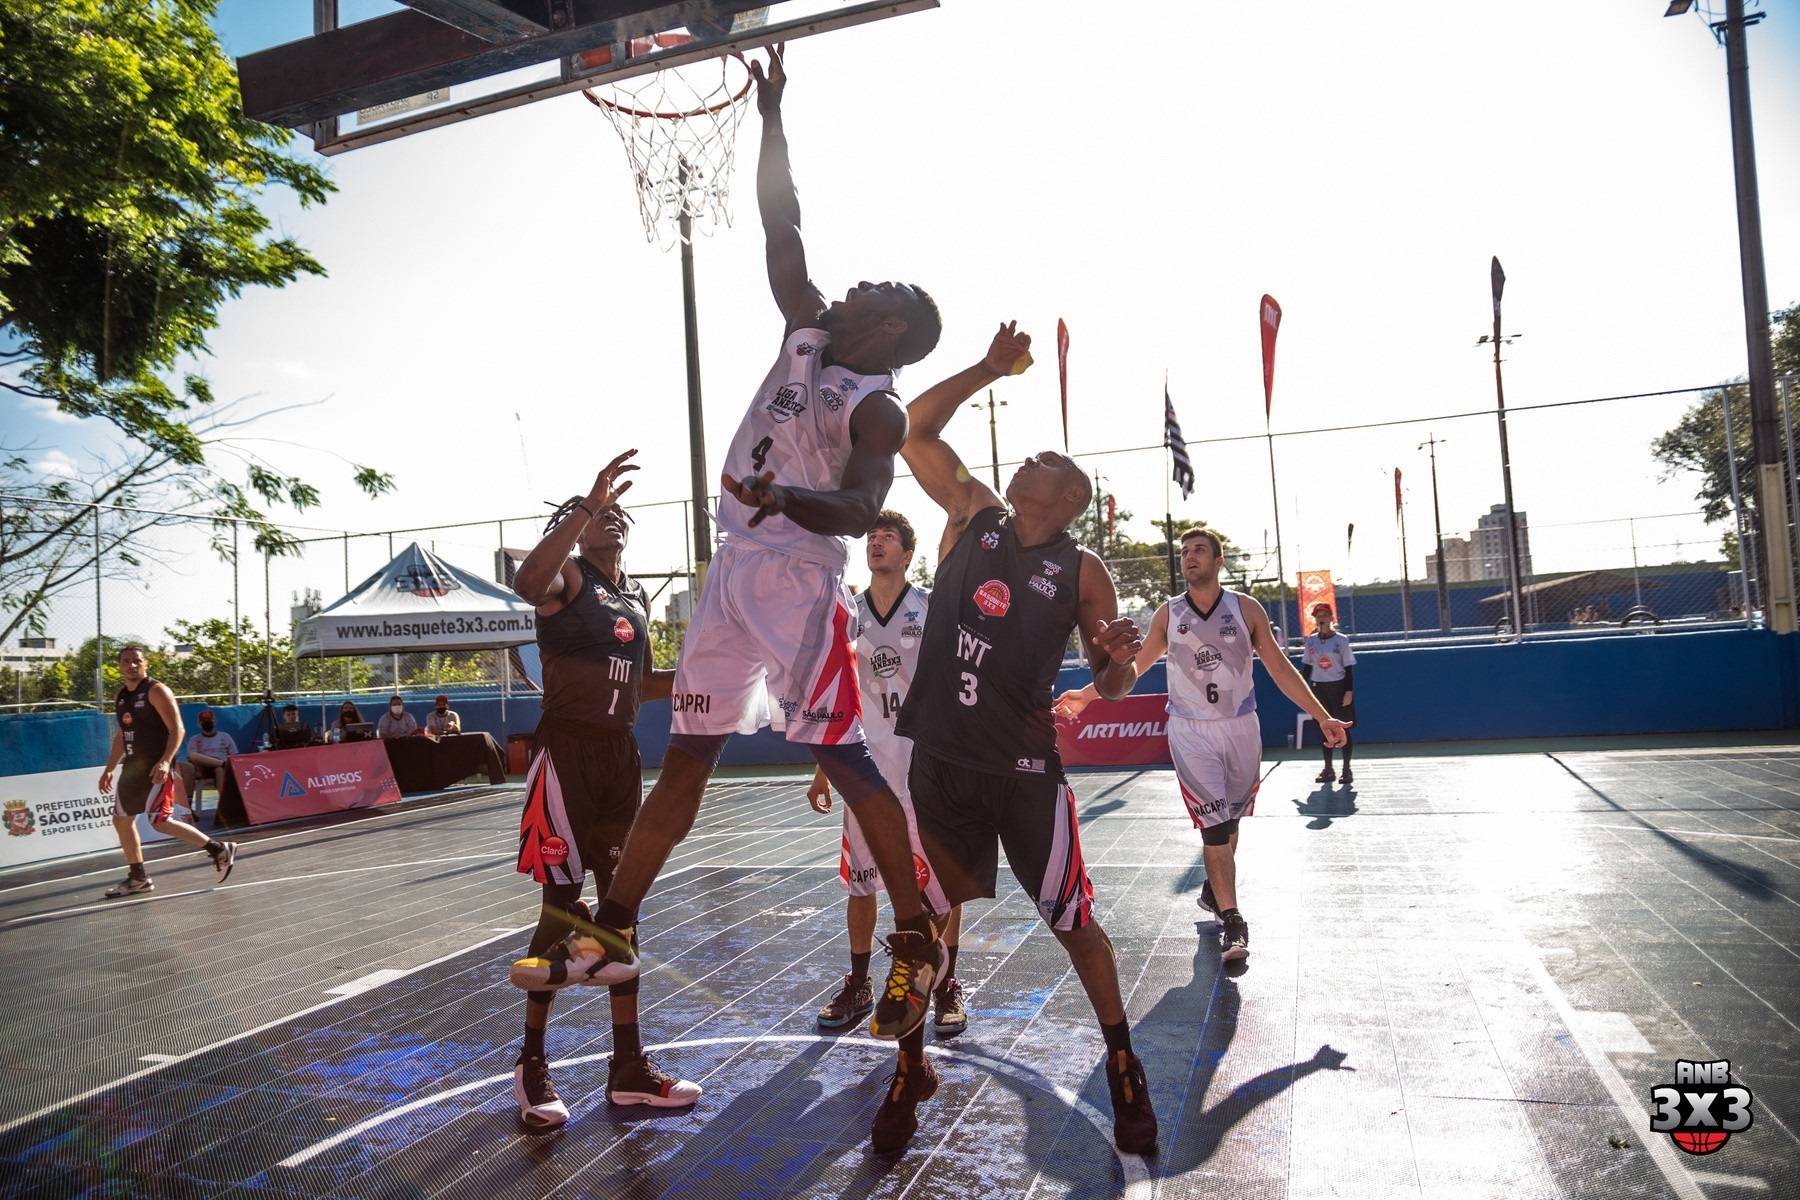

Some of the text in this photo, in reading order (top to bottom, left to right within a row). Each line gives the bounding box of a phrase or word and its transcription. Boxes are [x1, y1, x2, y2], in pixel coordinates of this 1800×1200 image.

[776, 386, 798, 401] LIGA
[751, 435, 774, 472] 4
[1028, 581, 1055, 598] PAULO
[1041, 577, 1057, 592] SÃO
[336, 614, 536, 639] www.basquete3x3.com.b
[608, 656, 633, 683] TNT
[958, 671, 978, 706] 3
[1206, 682, 1219, 704] 6
[673, 694, 711, 714] CAPRI
[881, 692, 902, 719] 14
[126, 744, 133, 755] 5
[36, 795, 116, 813] PREFEITURA DE
[38, 810, 71, 827] SÃO
[42, 824, 87, 836] ESPORTES
[541, 846, 564, 856] Claro
